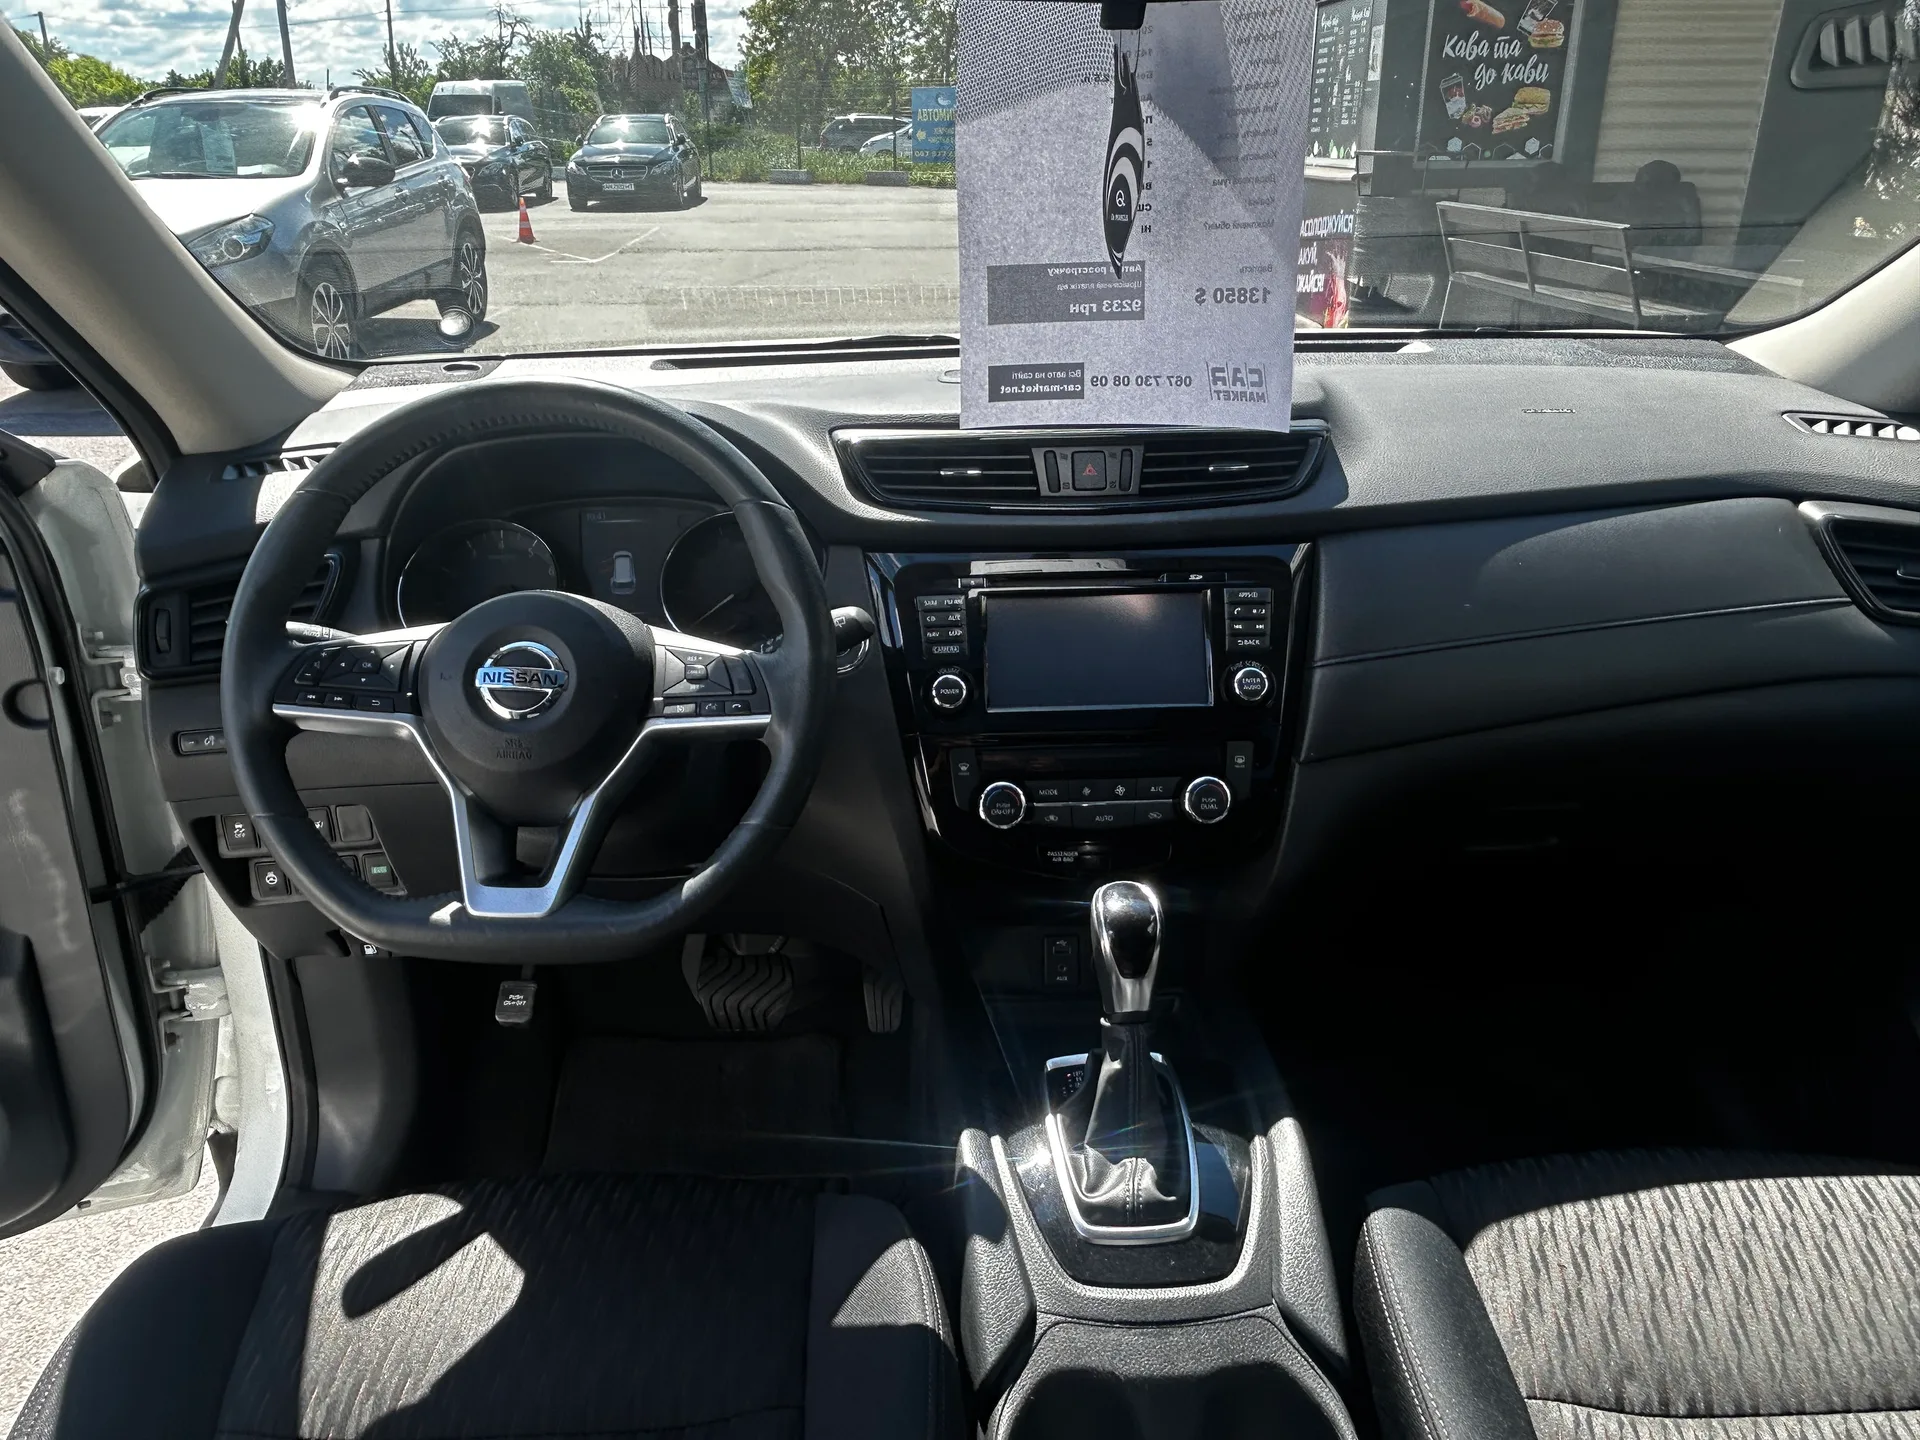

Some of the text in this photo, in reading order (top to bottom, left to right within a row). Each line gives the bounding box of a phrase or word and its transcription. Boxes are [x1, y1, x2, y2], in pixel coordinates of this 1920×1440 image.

[1442, 30, 1490, 61] Кава
[1474, 54, 1549, 90] до кави
[482, 671, 559, 686] NISSAN
[1039, 788, 1058, 796] MODE
[1094, 814, 1114, 822] AUTO
